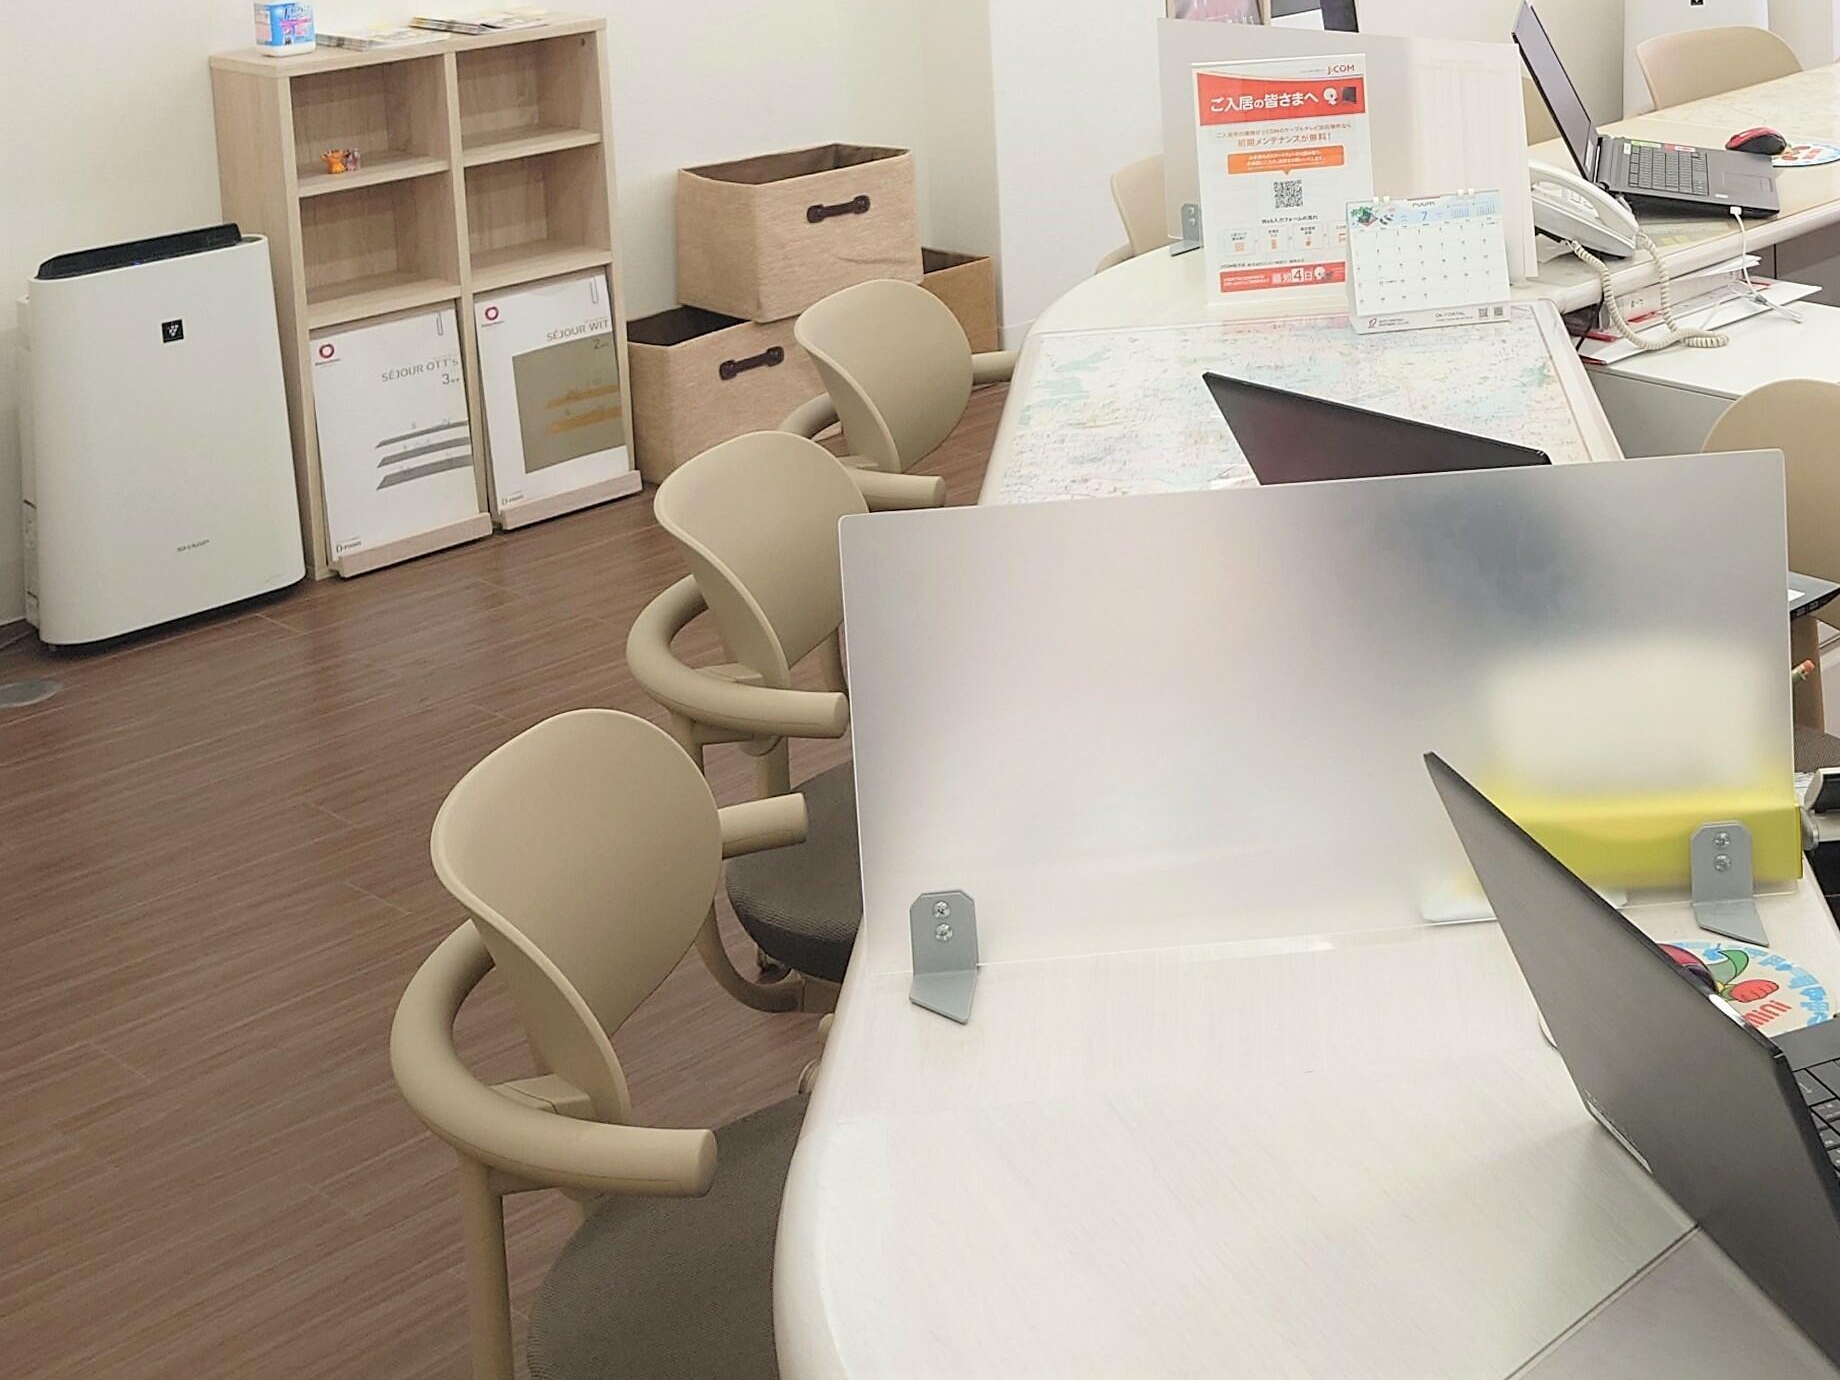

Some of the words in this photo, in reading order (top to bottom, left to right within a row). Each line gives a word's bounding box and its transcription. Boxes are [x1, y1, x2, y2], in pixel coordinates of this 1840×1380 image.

[1210, 91, 1319, 112] ご入居の皆さまへ
[1421, 211, 1428, 221] 7
